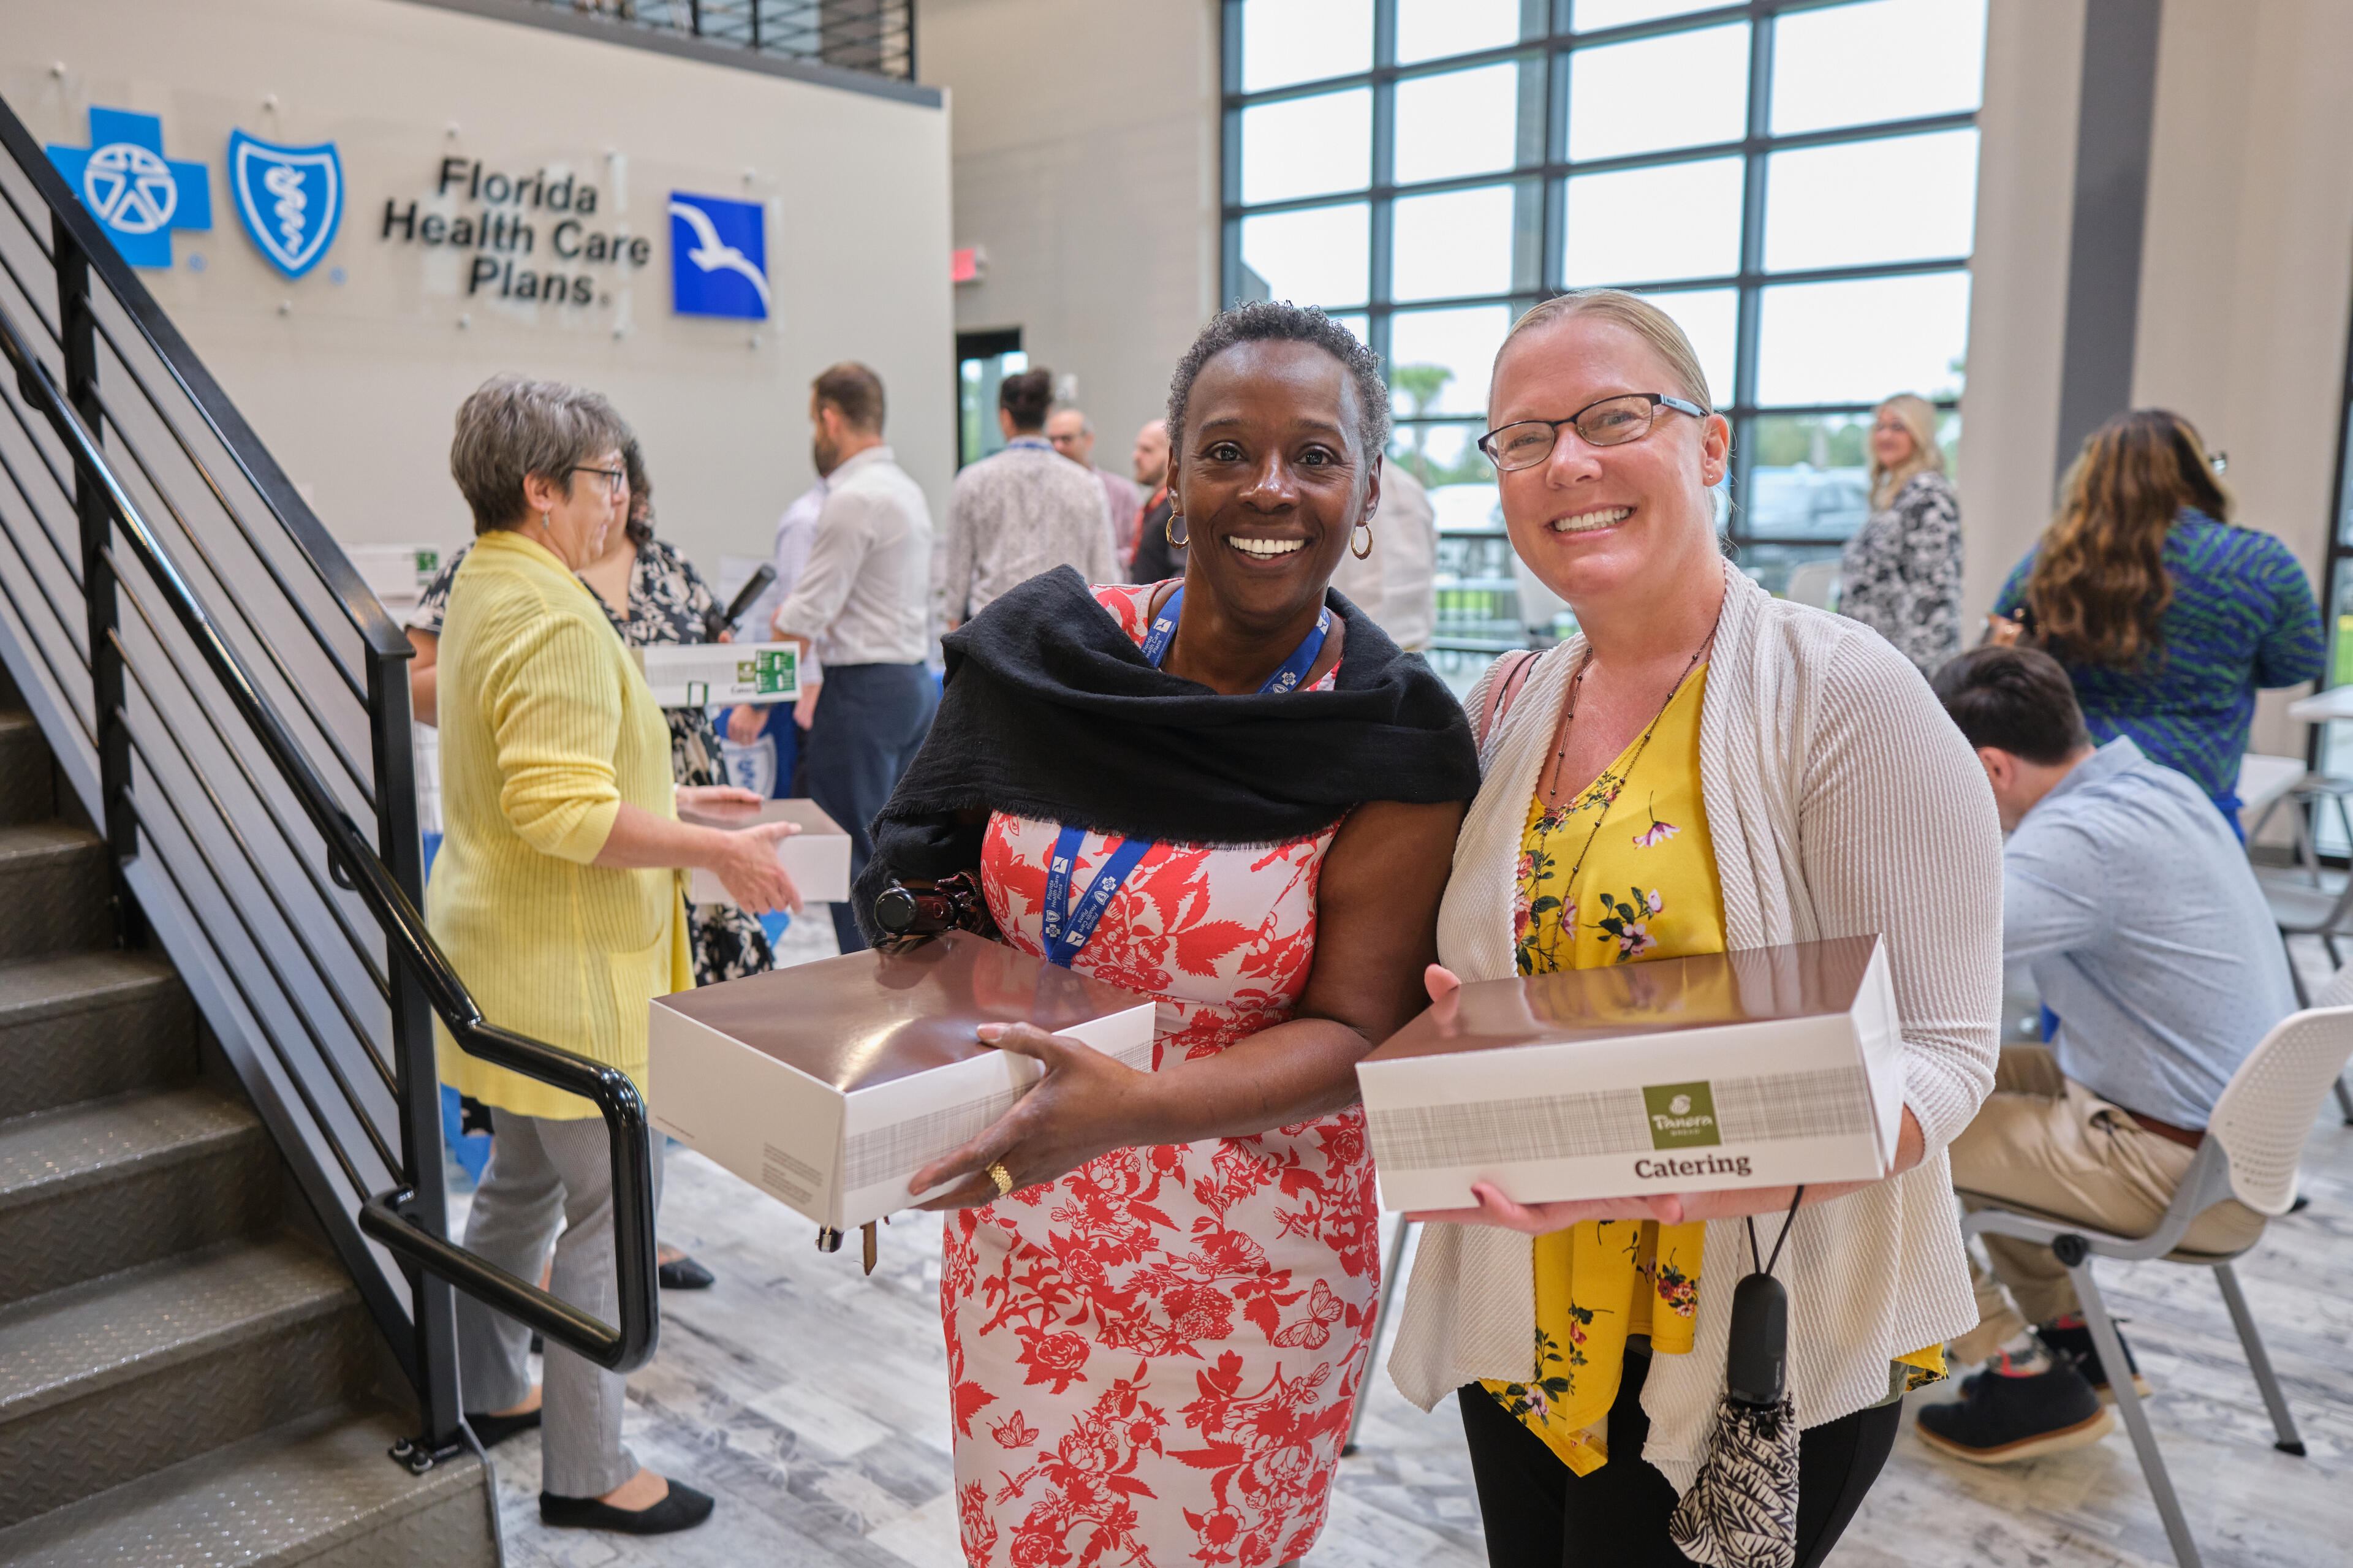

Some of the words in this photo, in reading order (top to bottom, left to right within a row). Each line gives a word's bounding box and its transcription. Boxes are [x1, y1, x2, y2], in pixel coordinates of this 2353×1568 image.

[438, 156, 599, 214] Florida
[382, 197, 535, 255] Health
[553, 219, 651, 267] Care
[468, 256, 594, 306] Plans
[1142, 635, 1153, 653] Florida
[1152, 632, 1161, 643] Care
[1152, 640, 1162, 654] Plans
[1078, 908, 1088, 923] Plans
[1086, 903, 1097, 920] Health
[1078, 920, 1088, 932] Care
[1086, 912, 1099, 930] Florida
[1651, 1114, 1713, 1131] Panera
[1635, 1154, 1752, 1179] Catering
